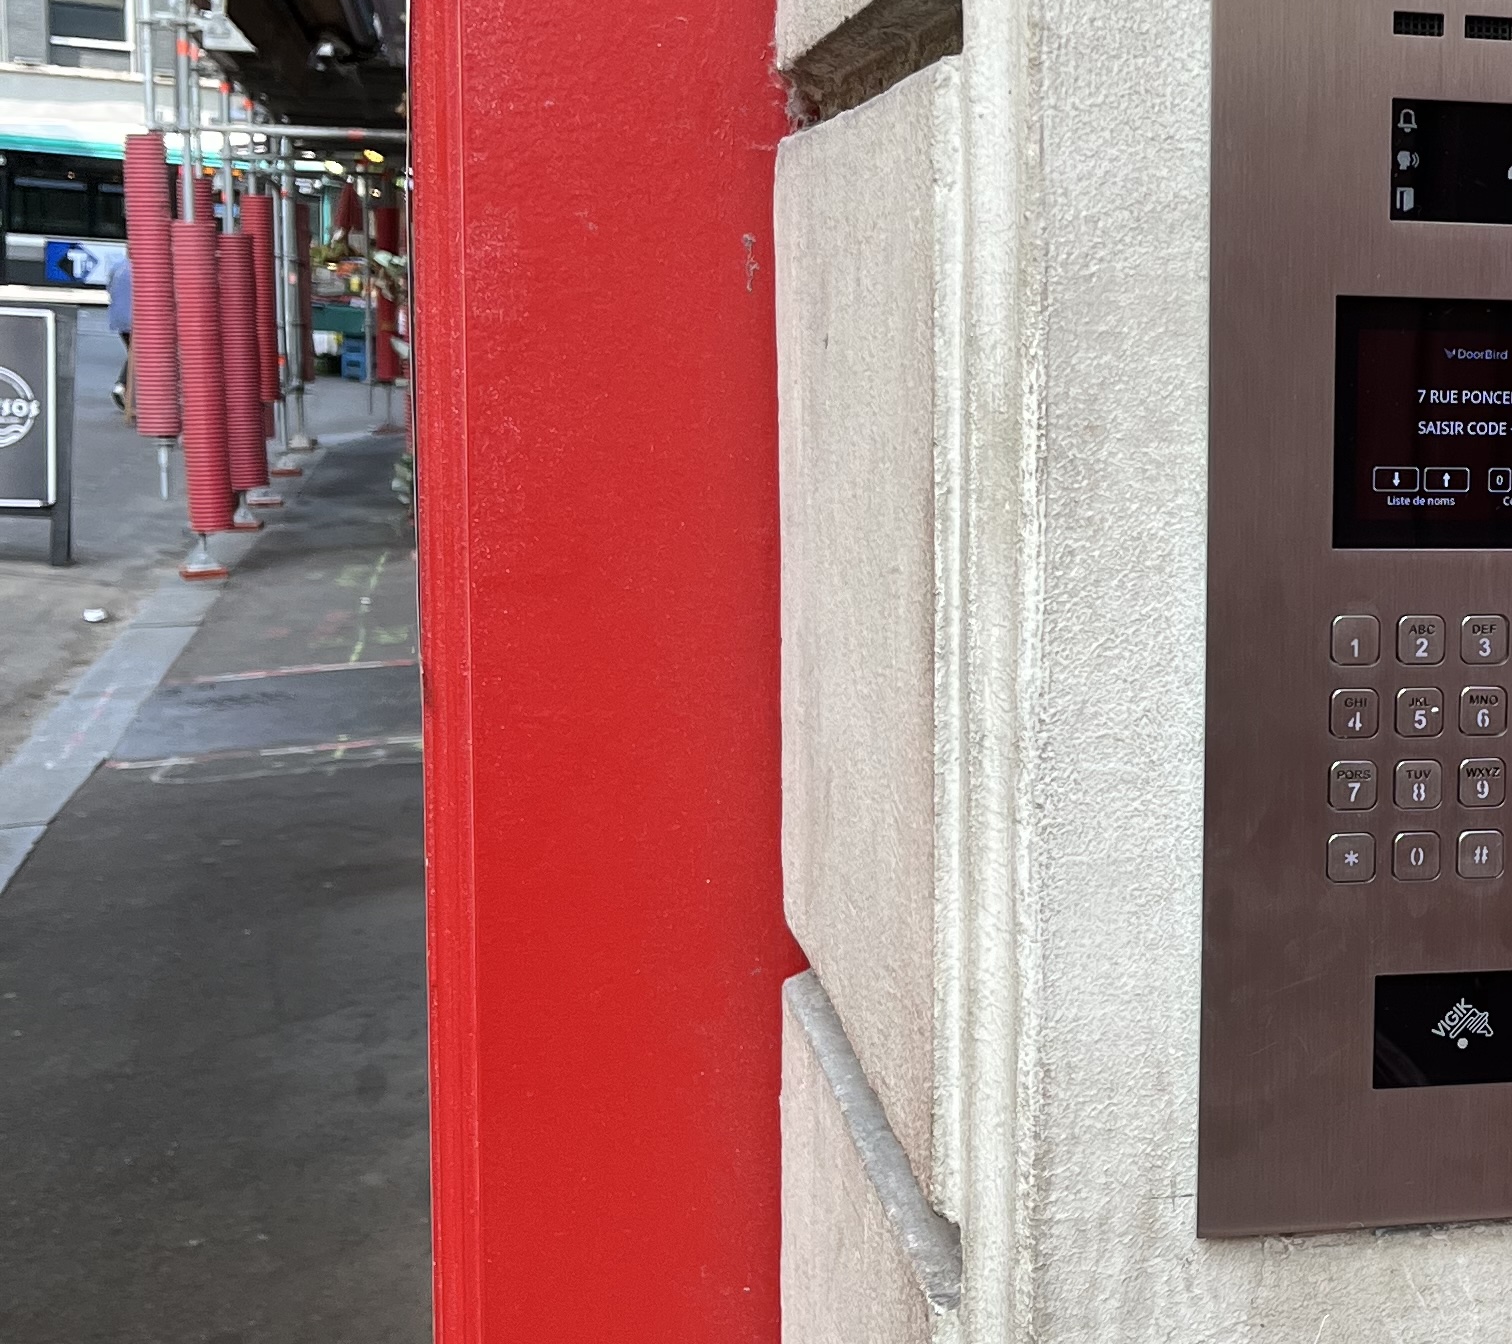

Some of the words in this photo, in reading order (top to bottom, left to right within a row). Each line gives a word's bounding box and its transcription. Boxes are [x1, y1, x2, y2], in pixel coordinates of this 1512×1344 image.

[1457, 348, 1508, 361] DoorBird
[1417, 389, 1427, 404] 7
[1430, 390, 1459, 404] RUE
[1418, 421, 1464, 436] SAISIR
[1467, 421, 1507, 436] CODE
[1496, 475, 1504, 486] 0
[1387, 496, 1411, 506] Liste
[1412, 496, 1426, 506] de
[1427, 497, 1455, 506] noms
[1408, 624, 1435, 635] ABC
[1472, 624, 1497, 635] DEF
[1350, 638, 1359, 658] 1
[1416, 638, 1429, 657] 2
[1478, 637, 1491, 657] 3
[1344, 697, 1367, 708] GHI
[1408, 696, 1430, 707] JKL
[1469, 695, 1498, 706] MNO
[1348, 712, 1362, 731] 4
[1414, 710, 1427, 729] 5
[1477, 709, 1490, 728] 6
[1406, 769, 1432, 780] TUV
[1466, 767, 1501, 778] WXYZ
[1348, 782, 1361, 802] 7
[1412, 783, 1426, 802] 8
[1476, 780, 1489, 799] 9
[1410, 847, 1424, 866] 0
[1473, 846, 1489, 865] #
[1431, 998, 1473, 1037] VIGIK
